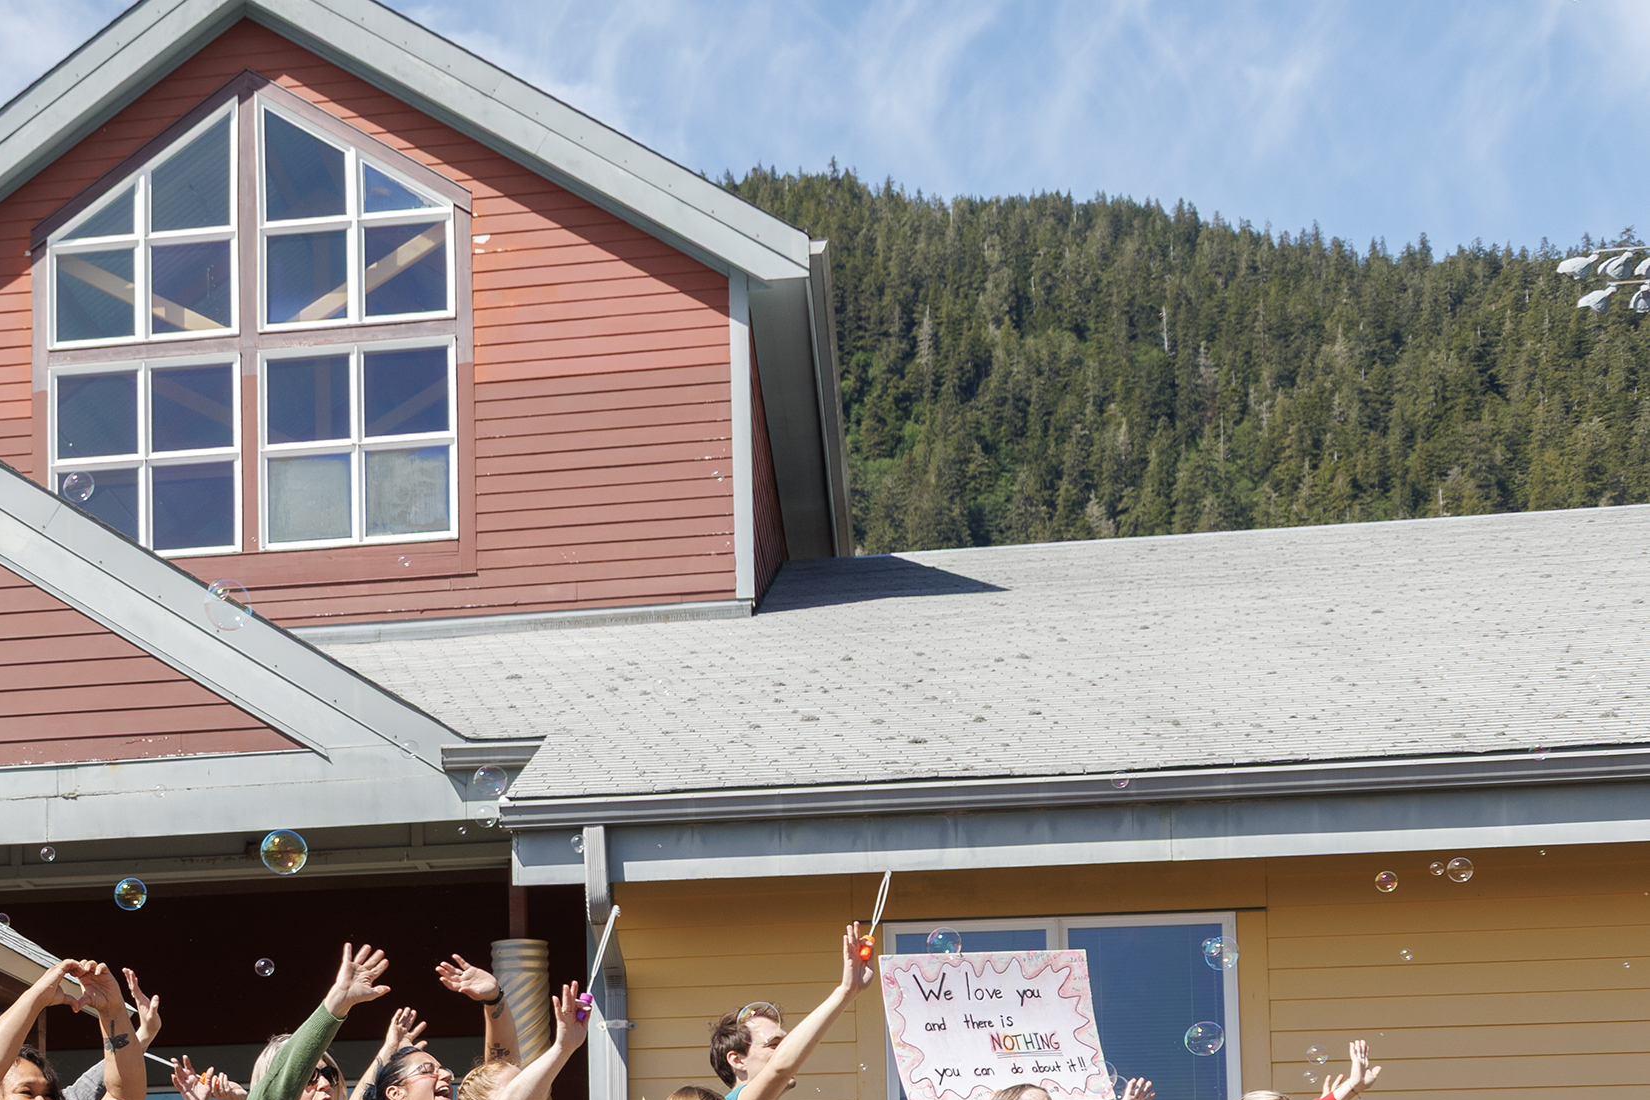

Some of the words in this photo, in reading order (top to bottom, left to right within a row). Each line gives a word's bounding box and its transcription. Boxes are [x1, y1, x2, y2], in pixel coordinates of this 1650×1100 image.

[912, 972, 953, 1002] We
[964, 971, 1003, 1001] love
[1016, 986, 1042, 1007] you
[924, 1016, 947, 1032] and
[963, 1013, 994, 1030] there
[1000, 1014, 1014, 1029] is
[990, 1032, 1060, 1052] NOTHING
[934, 1065, 961, 1086] you
[973, 1065, 995, 1077] can
[1011, 1062, 1024, 1075] do
[1031, 1059, 1062, 1075] about
